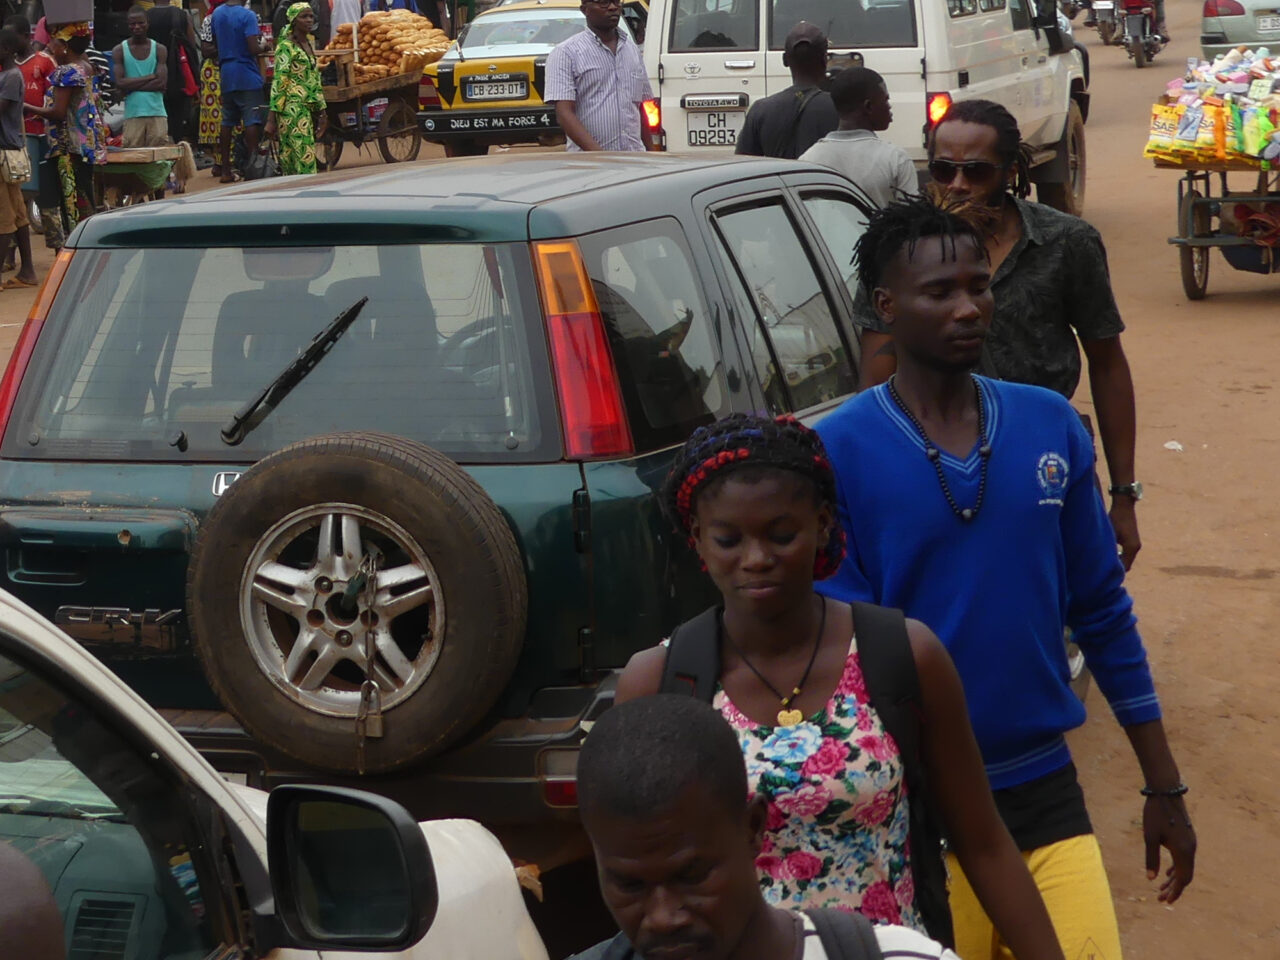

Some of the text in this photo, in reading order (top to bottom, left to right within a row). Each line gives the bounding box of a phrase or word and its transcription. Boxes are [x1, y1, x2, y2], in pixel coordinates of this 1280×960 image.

[688, 99, 718, 107] TOYOTA
[450, 113, 550, 130] DIEU EST MA FORCE 4
[708, 113, 726, 128] CH
[689, 129, 736, 145] 09293
